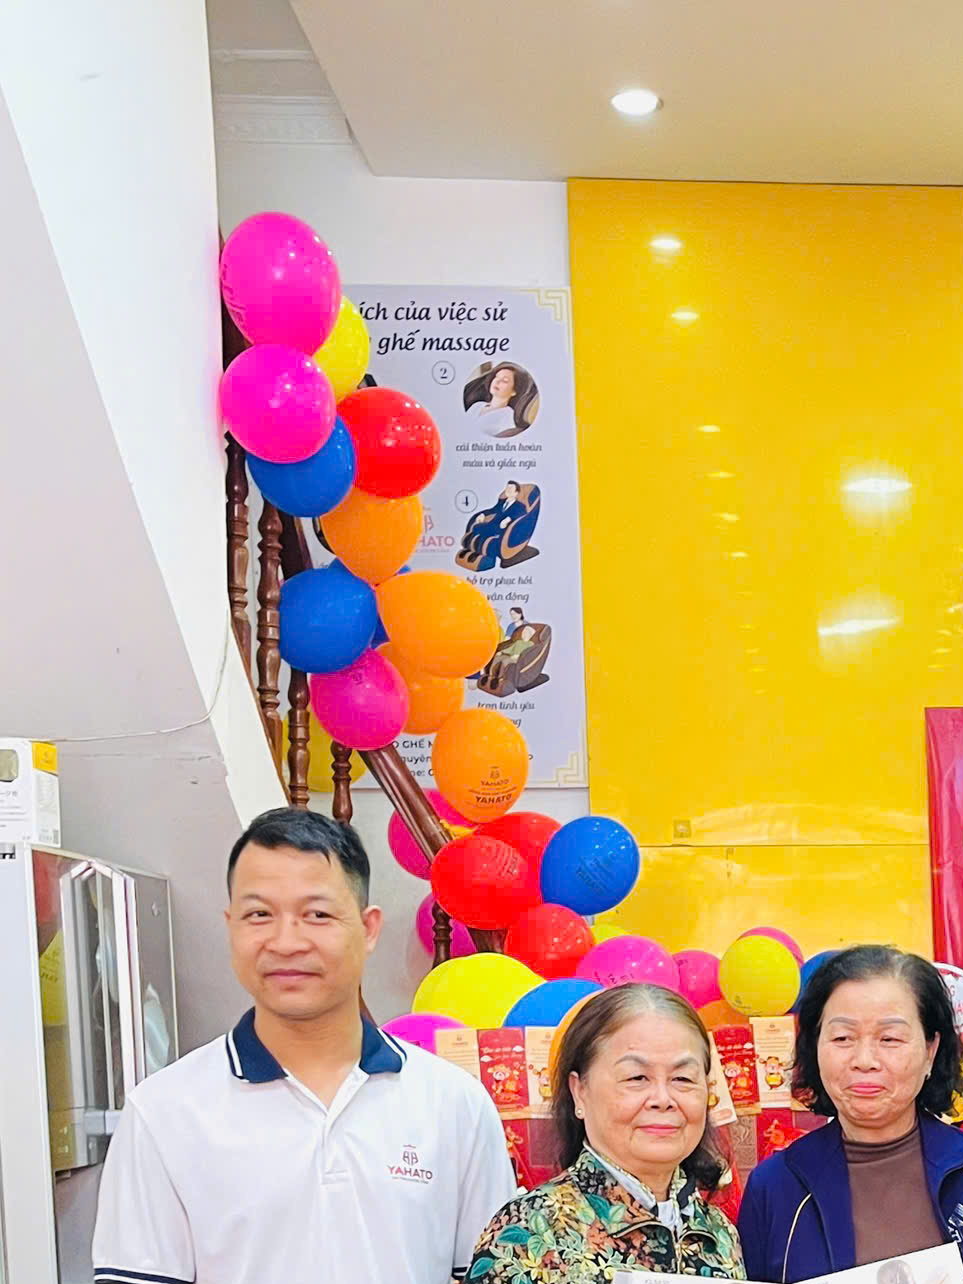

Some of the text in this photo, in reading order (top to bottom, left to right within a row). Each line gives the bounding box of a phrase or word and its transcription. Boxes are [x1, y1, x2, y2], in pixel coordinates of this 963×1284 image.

[394, 301, 431, 321] của
[438, 302, 477, 325] việc
[482, 301, 508, 321] sử
[377, 329, 510, 356] ghế massage
[387, 1164, 433, 1180] YAHATO
